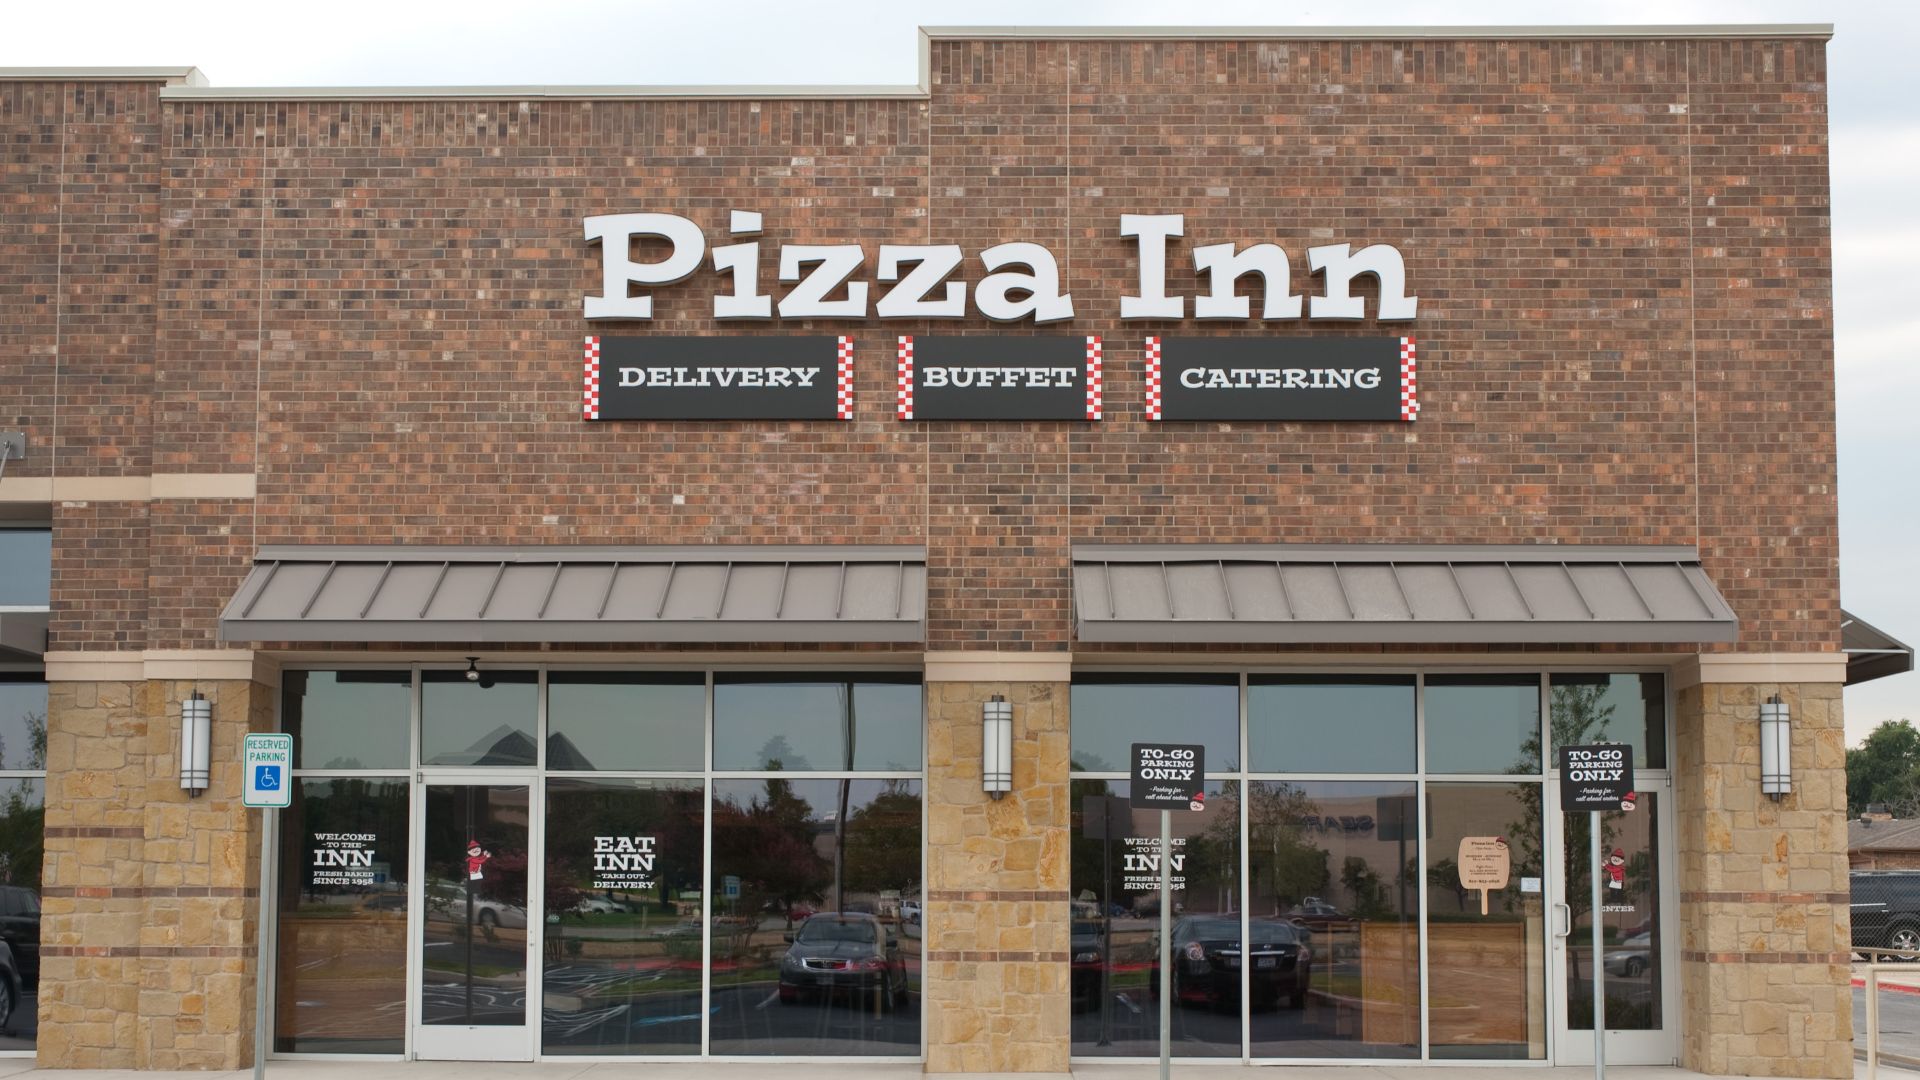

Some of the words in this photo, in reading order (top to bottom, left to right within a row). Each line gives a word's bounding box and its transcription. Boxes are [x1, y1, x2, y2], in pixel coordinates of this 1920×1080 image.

[583, 209, 1075, 326] Pizza
[1120, 213, 1418, 322] Inn
[618, 366, 821, 388] DELIVERY
[922, 366, 1077, 388] BUFFET
[1179, 366, 1382, 390] CATERING
[247, 740, 289, 750] RESERVED
[249, 752, 286, 762] PARKING
[1140, 748, 1195, 760] TO-GO
[1568, 750, 1623, 761] TO-GO
[1140, 759, 1194, 768] PARKING
[1568, 760, 1623, 769] PARKING
[1140, 767, 1195, 781] ONLY
[1569, 769, 1624, 782] ONLY
[314, 833, 376, 841] WELCOME
[1124, 838, 1186, 846] WELCME
[594, 836, 655, 852] EAT
[313, 849, 375, 867] INN
[594, 853, 656, 871] INN
[313, 877, 350, 885] SINCE
[351, 878, 374, 886] 1958
[593, 881, 656, 889] DELIVERY
[1123, 882, 1161, 890] SINCE
